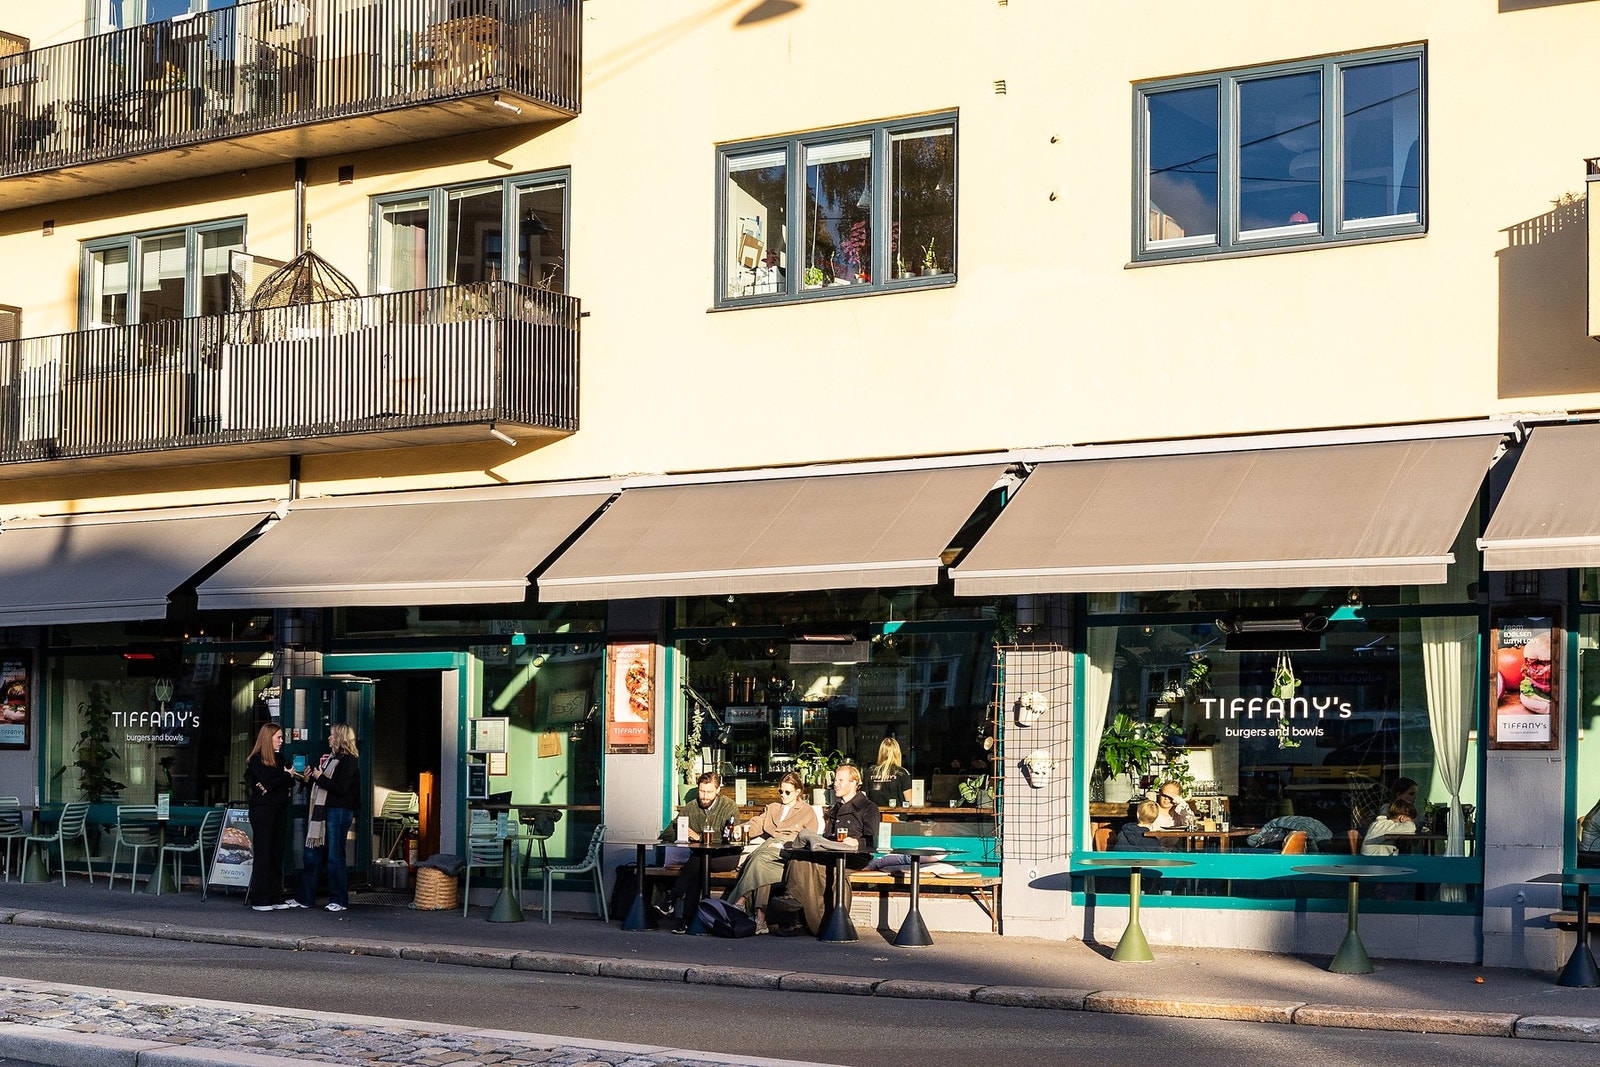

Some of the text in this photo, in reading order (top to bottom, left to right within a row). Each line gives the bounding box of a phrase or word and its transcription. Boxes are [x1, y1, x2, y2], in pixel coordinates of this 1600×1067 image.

[1200, 697, 1352, 719] TIFFANY's
[112, 711, 200, 728] TIFFANY's
[614, 727, 646, 735] TIFFANY's
[1225, 727, 1324, 738] burgers and bowls
[126, 734, 151, 743] burgers
[220, 869, 245, 877] TIFFANY's
